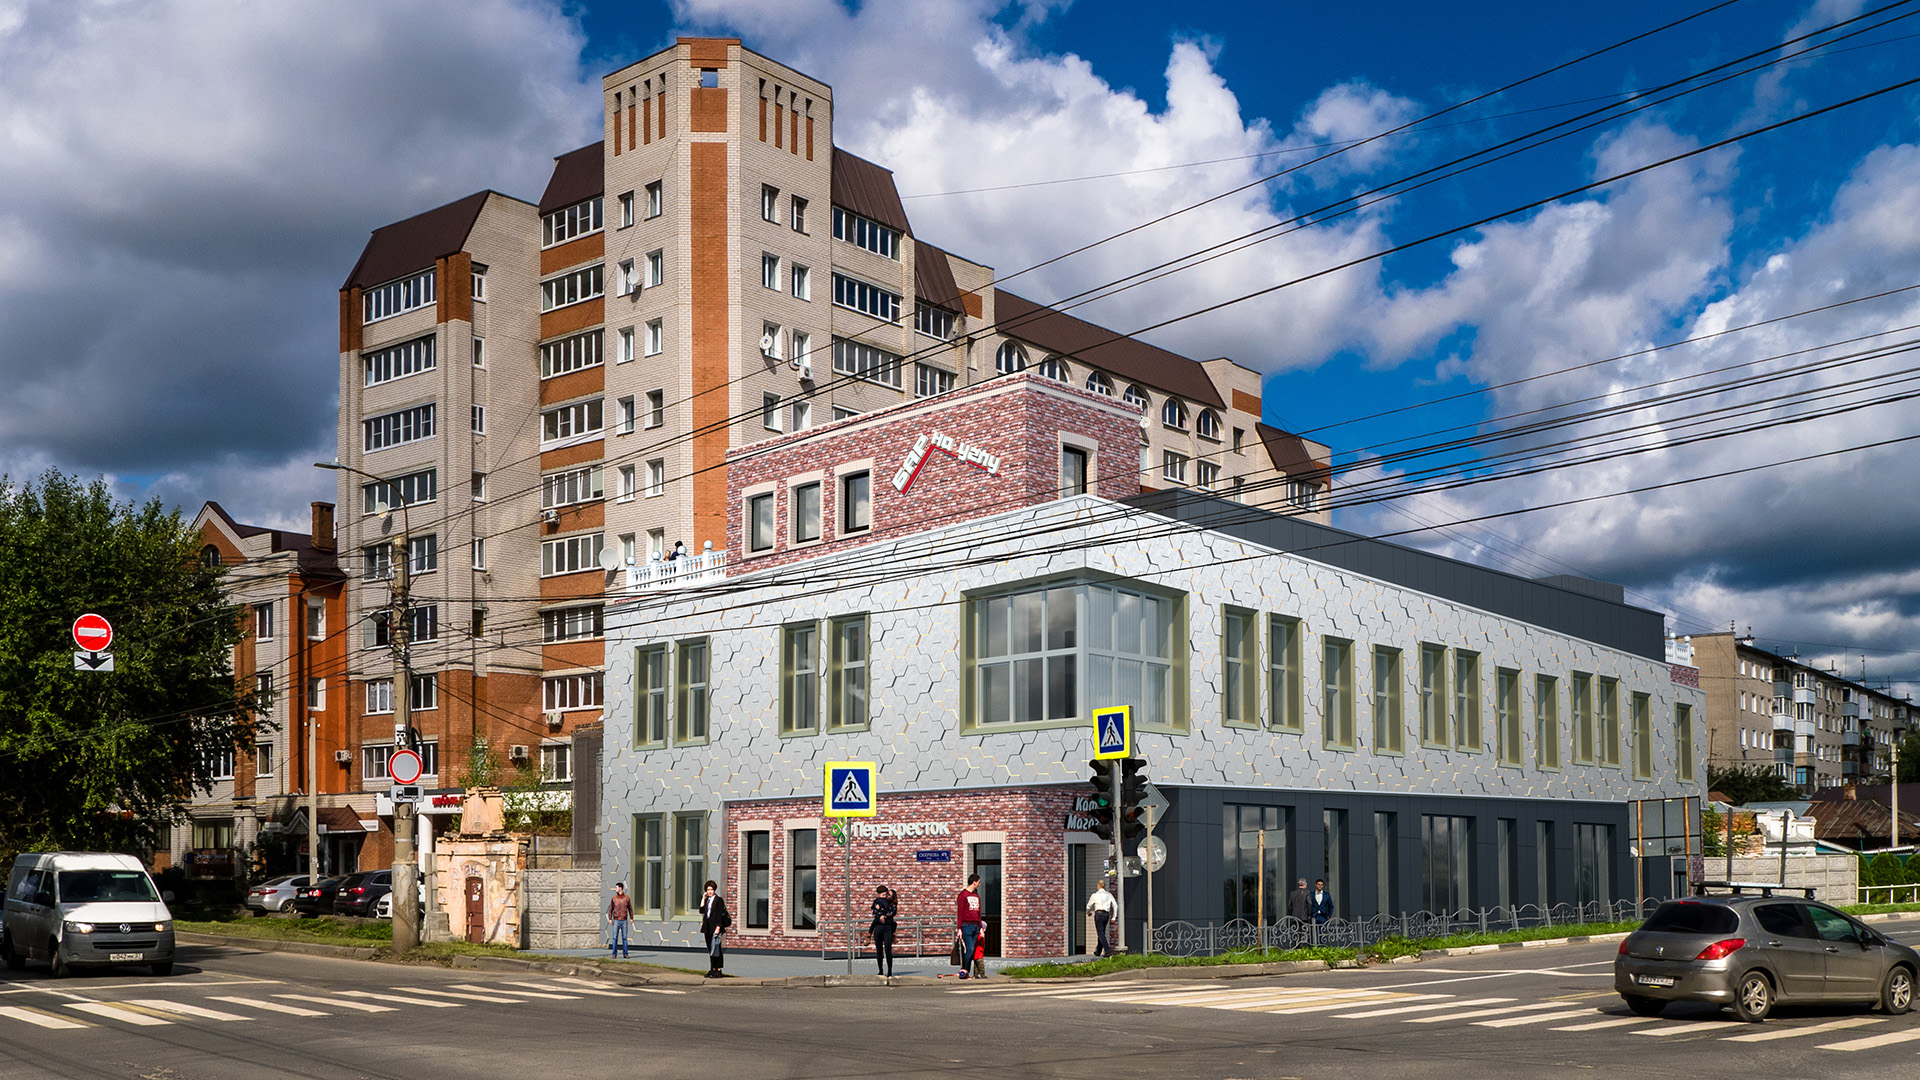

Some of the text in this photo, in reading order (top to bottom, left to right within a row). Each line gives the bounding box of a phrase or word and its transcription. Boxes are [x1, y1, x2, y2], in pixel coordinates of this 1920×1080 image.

[891, 434, 929, 493] БАР
[957, 442, 1002, 474] углу
[853, 821, 951, 841] Перекресток
